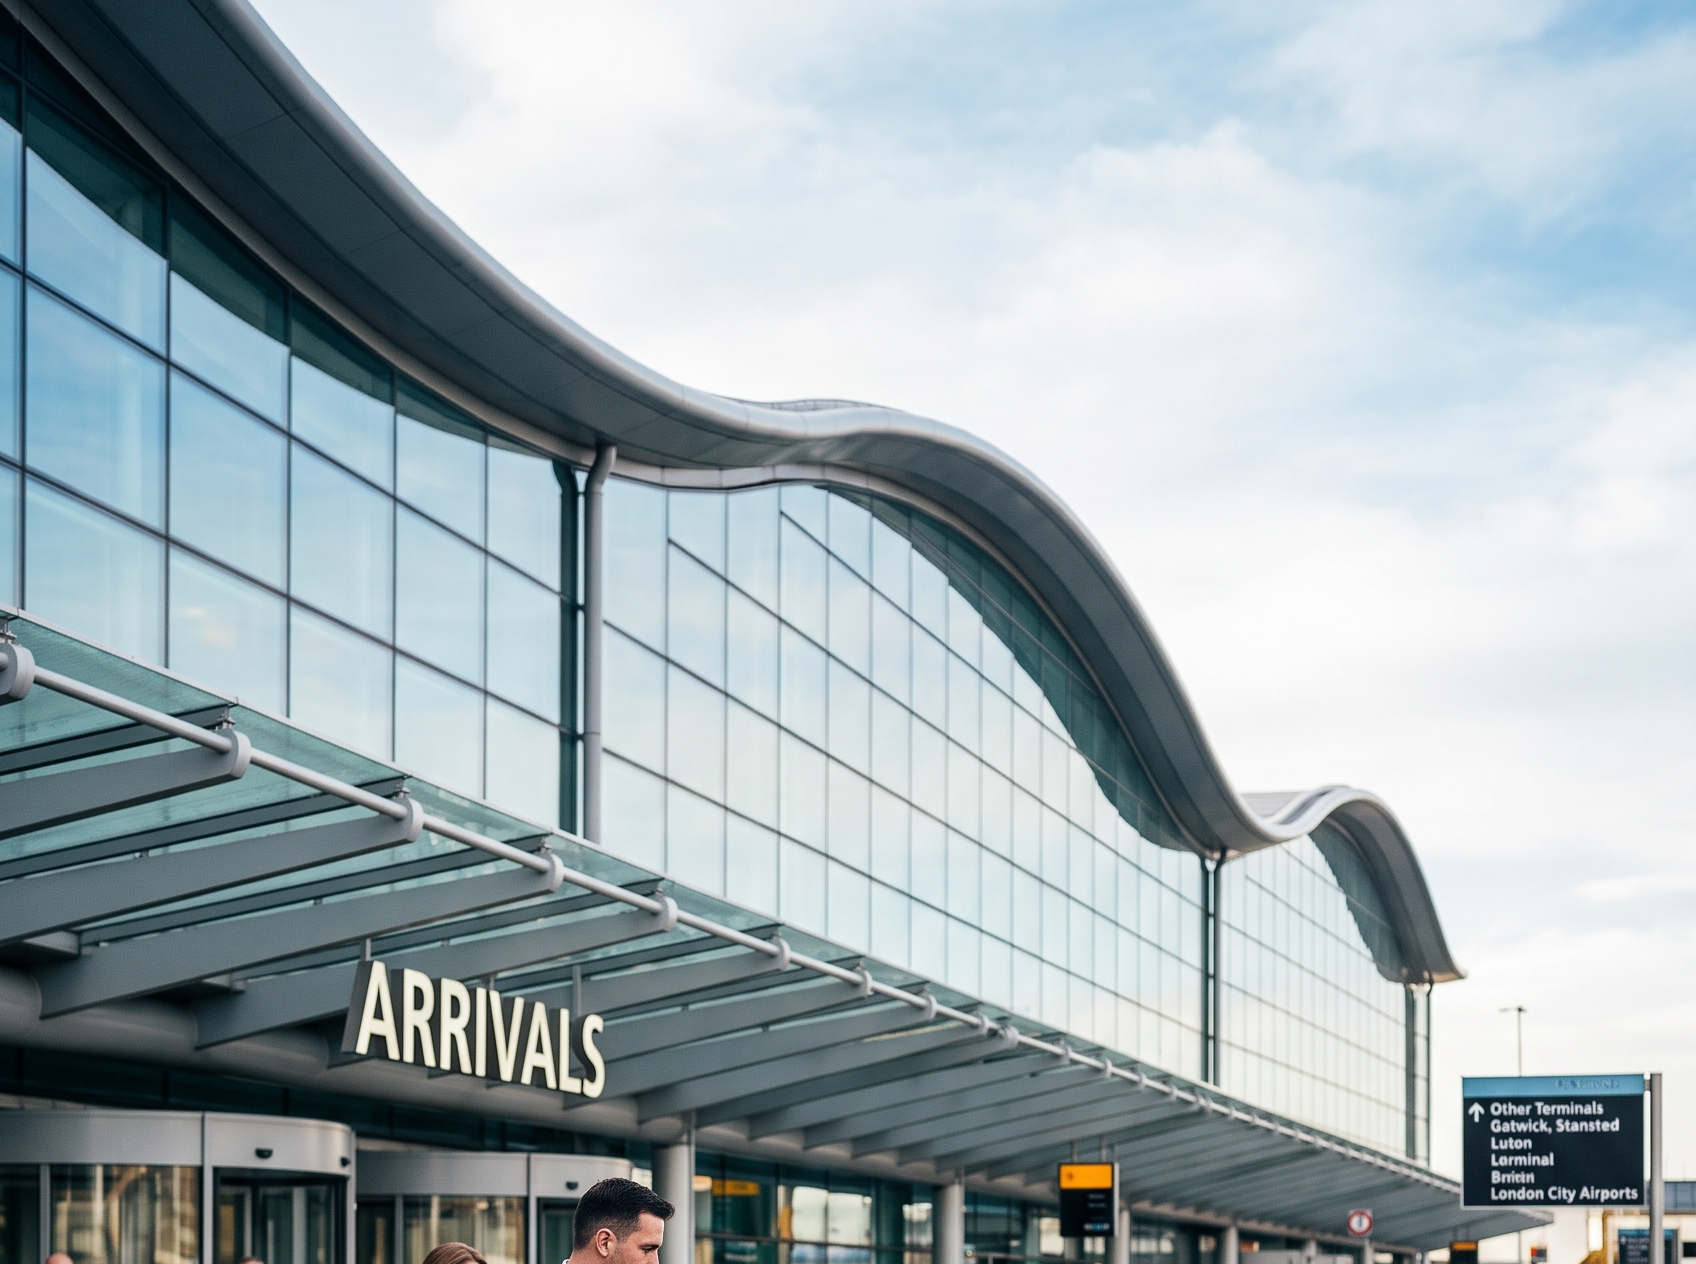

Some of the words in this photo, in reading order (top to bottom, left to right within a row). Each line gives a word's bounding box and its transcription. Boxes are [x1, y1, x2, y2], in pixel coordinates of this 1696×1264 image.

[355, 960, 605, 1098] ARRIVALS
[1490, 1102, 1532, 1116] Other
[1535, 1101, 1604, 1115] Terminals
[1555, 1118, 1620, 1132] Stansted
[1491, 1137, 1532, 1150] Luton
[1491, 1187, 1544, 1200] London
[1548, 1186, 1576, 1203] City
[1579, 1186, 1638, 1202] Airports
